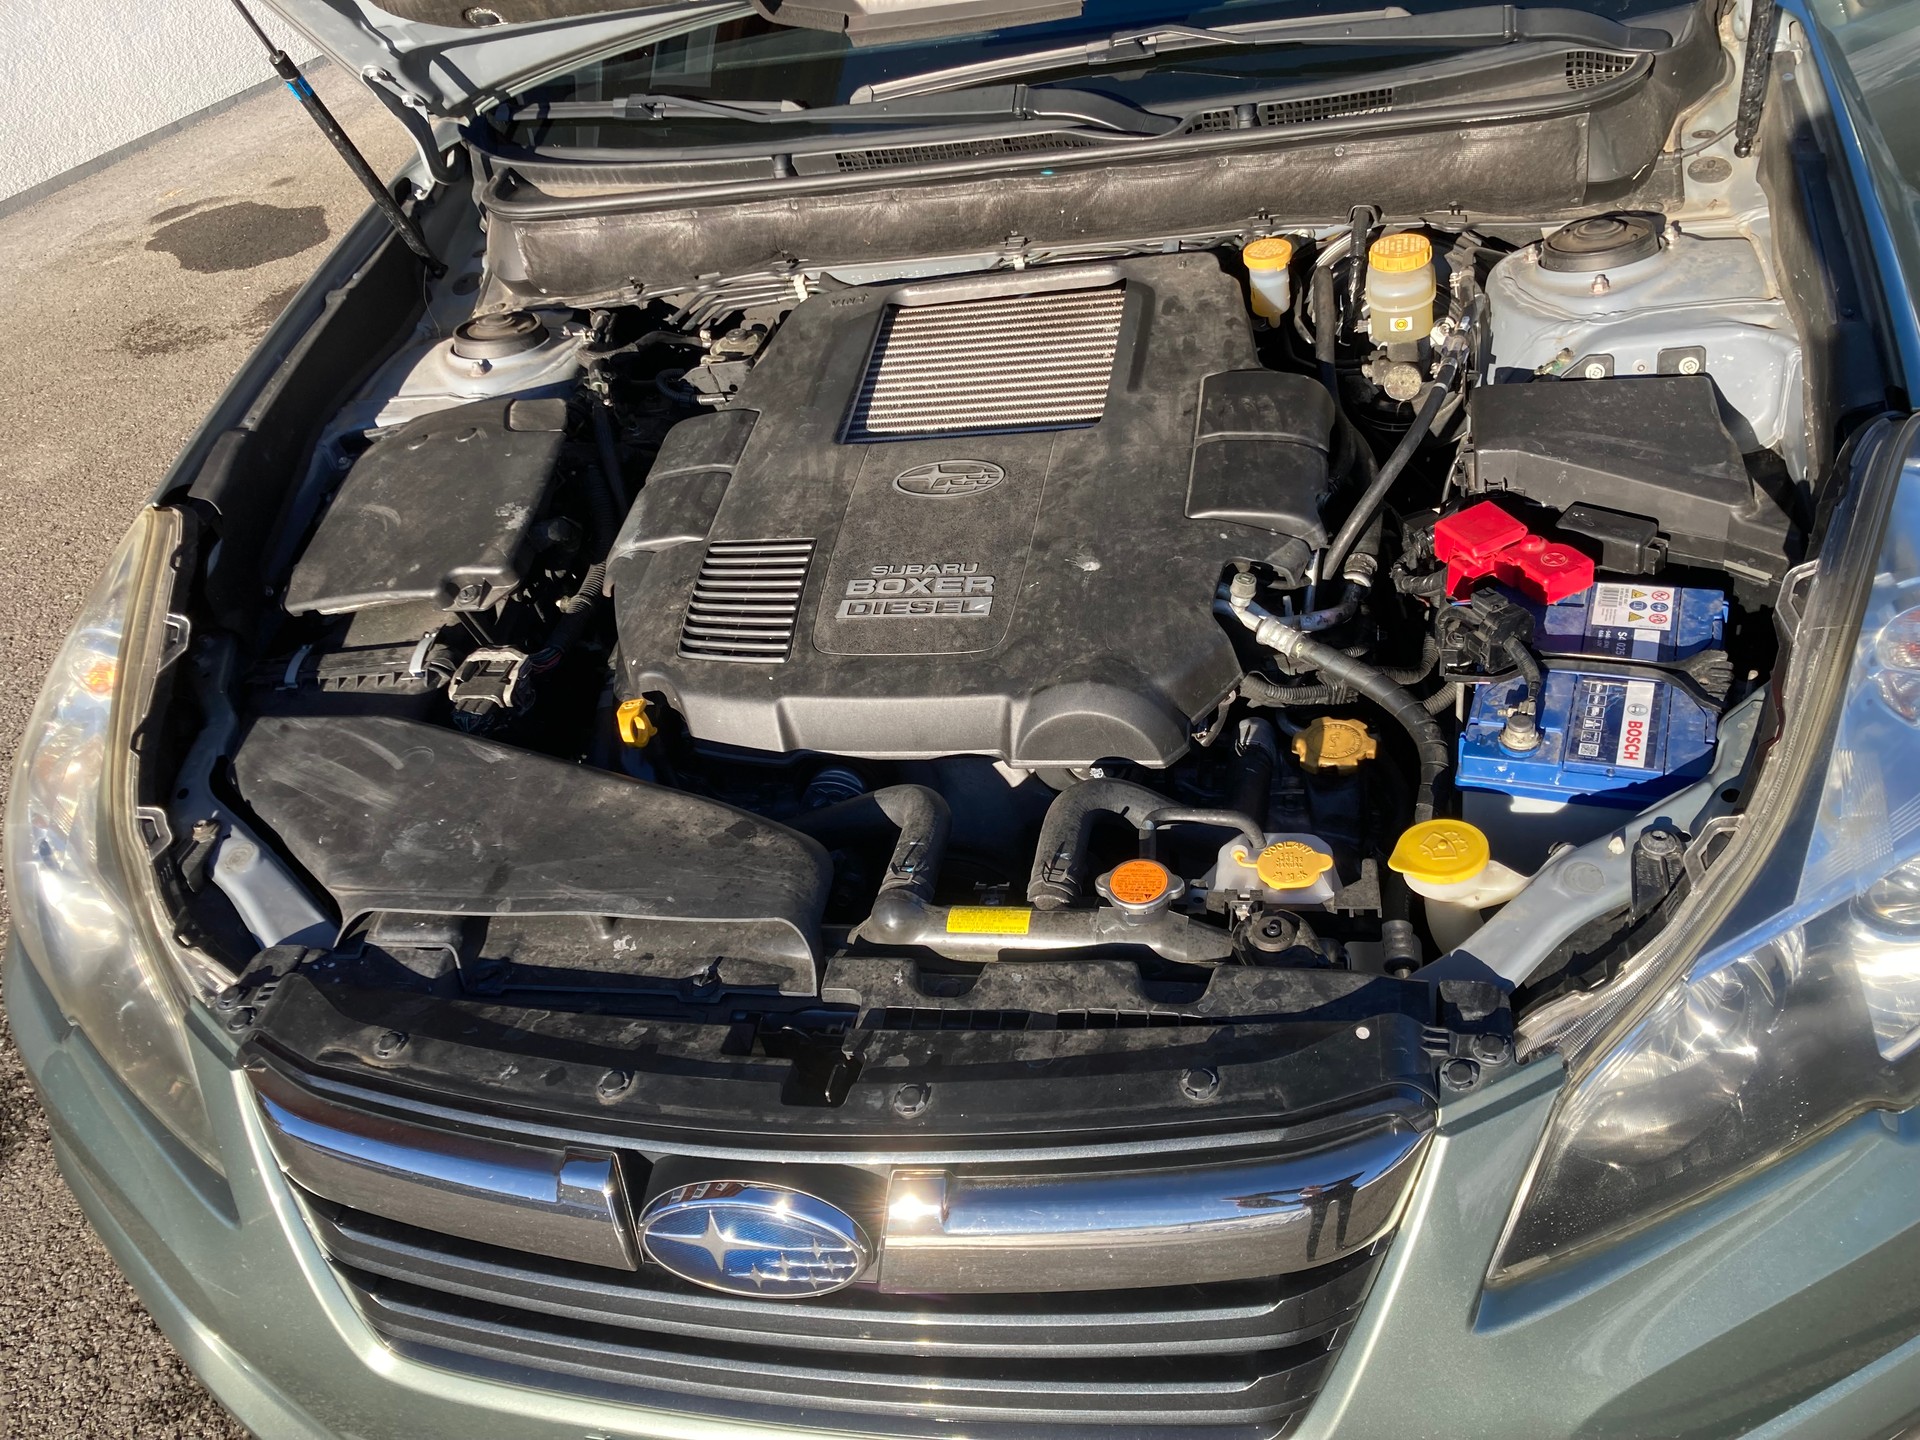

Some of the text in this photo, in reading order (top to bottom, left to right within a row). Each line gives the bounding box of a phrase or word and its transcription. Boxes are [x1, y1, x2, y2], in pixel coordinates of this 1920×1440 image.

[871, 562, 980, 576] SUBARU
[845, 575, 997, 597] BOXER
[846, 599, 986, 616] DIESEL
[1617, 631, 1628, 641] S4
[1623, 720, 1643, 761] BOSCH
[1263, 841, 1315, 857] COOLANT
